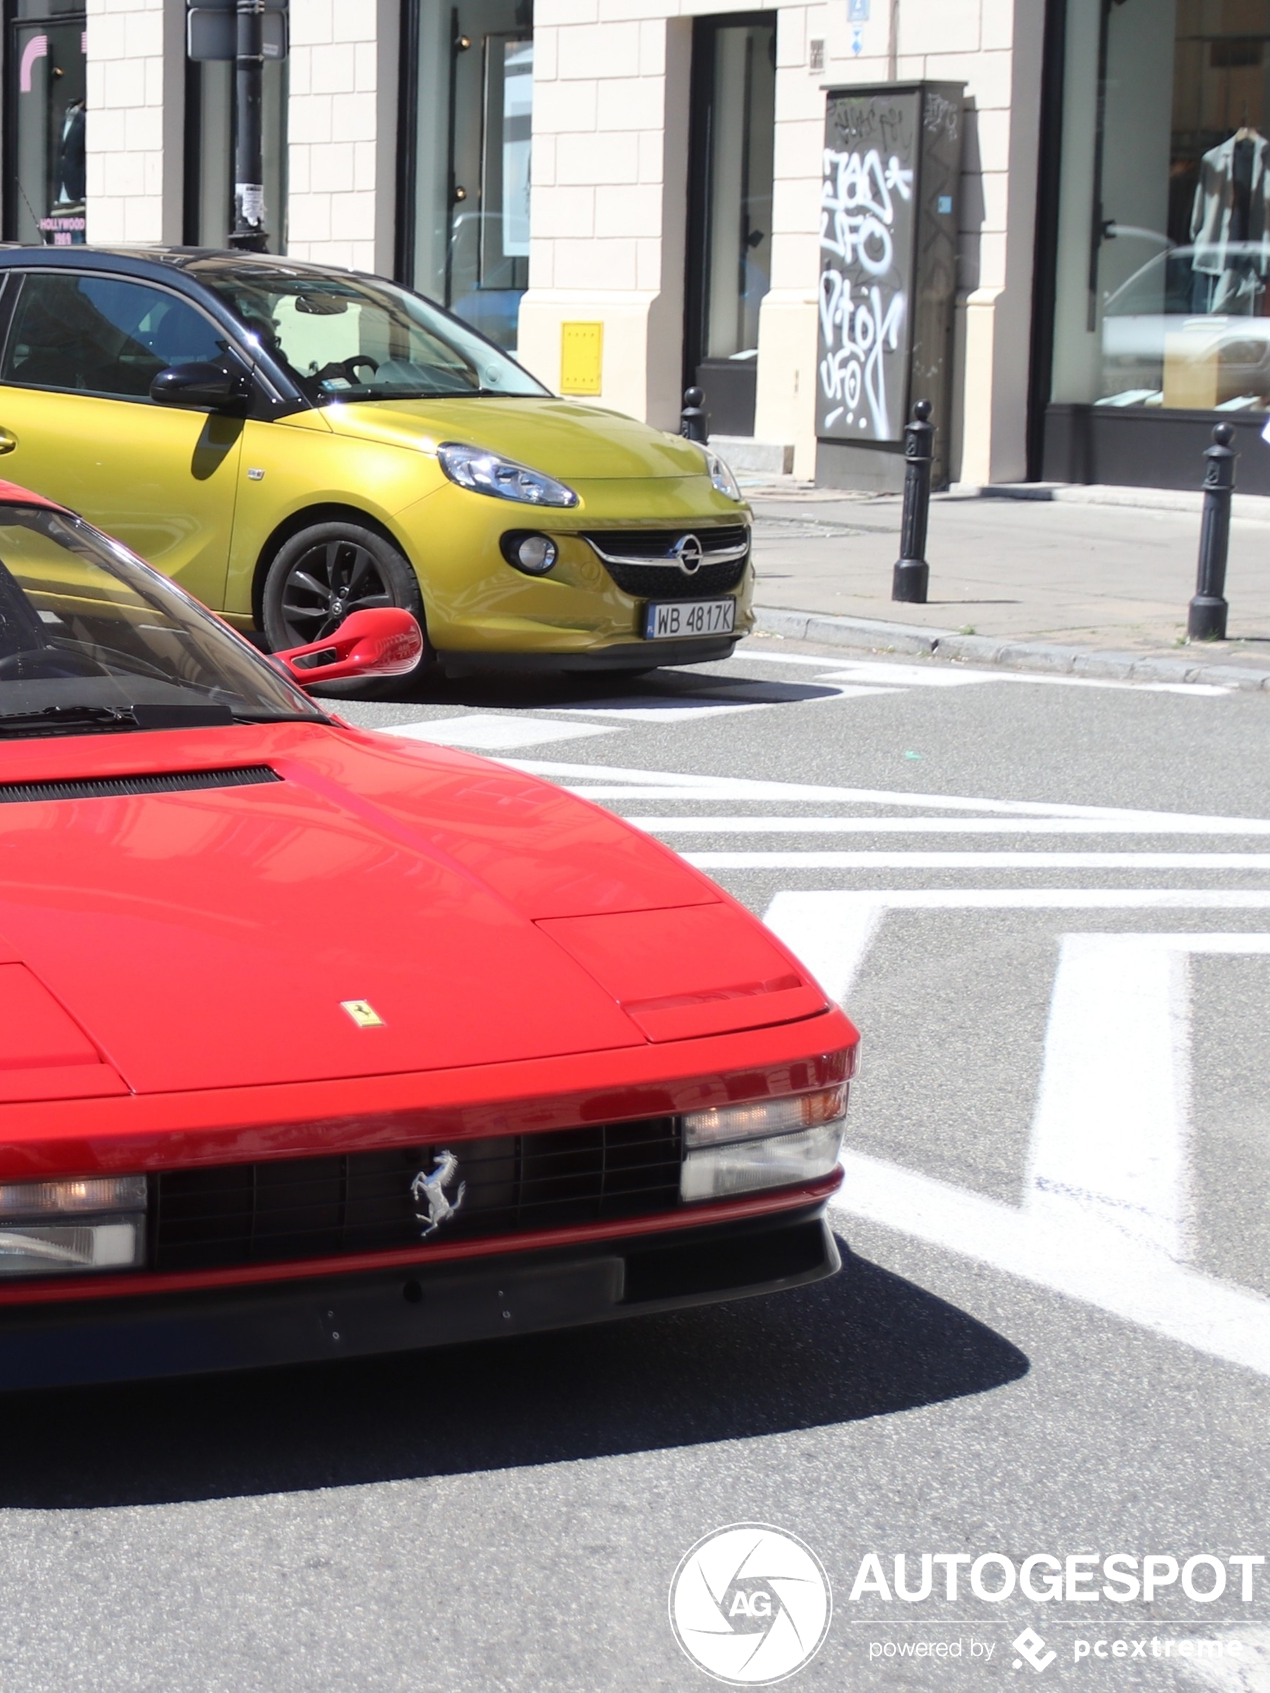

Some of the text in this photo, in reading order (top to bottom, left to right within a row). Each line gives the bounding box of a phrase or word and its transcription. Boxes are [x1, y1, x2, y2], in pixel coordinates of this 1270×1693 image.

[40, 217, 85, 231] HOLLYWOOD
[657, 603, 733, 635] WB 4817K
